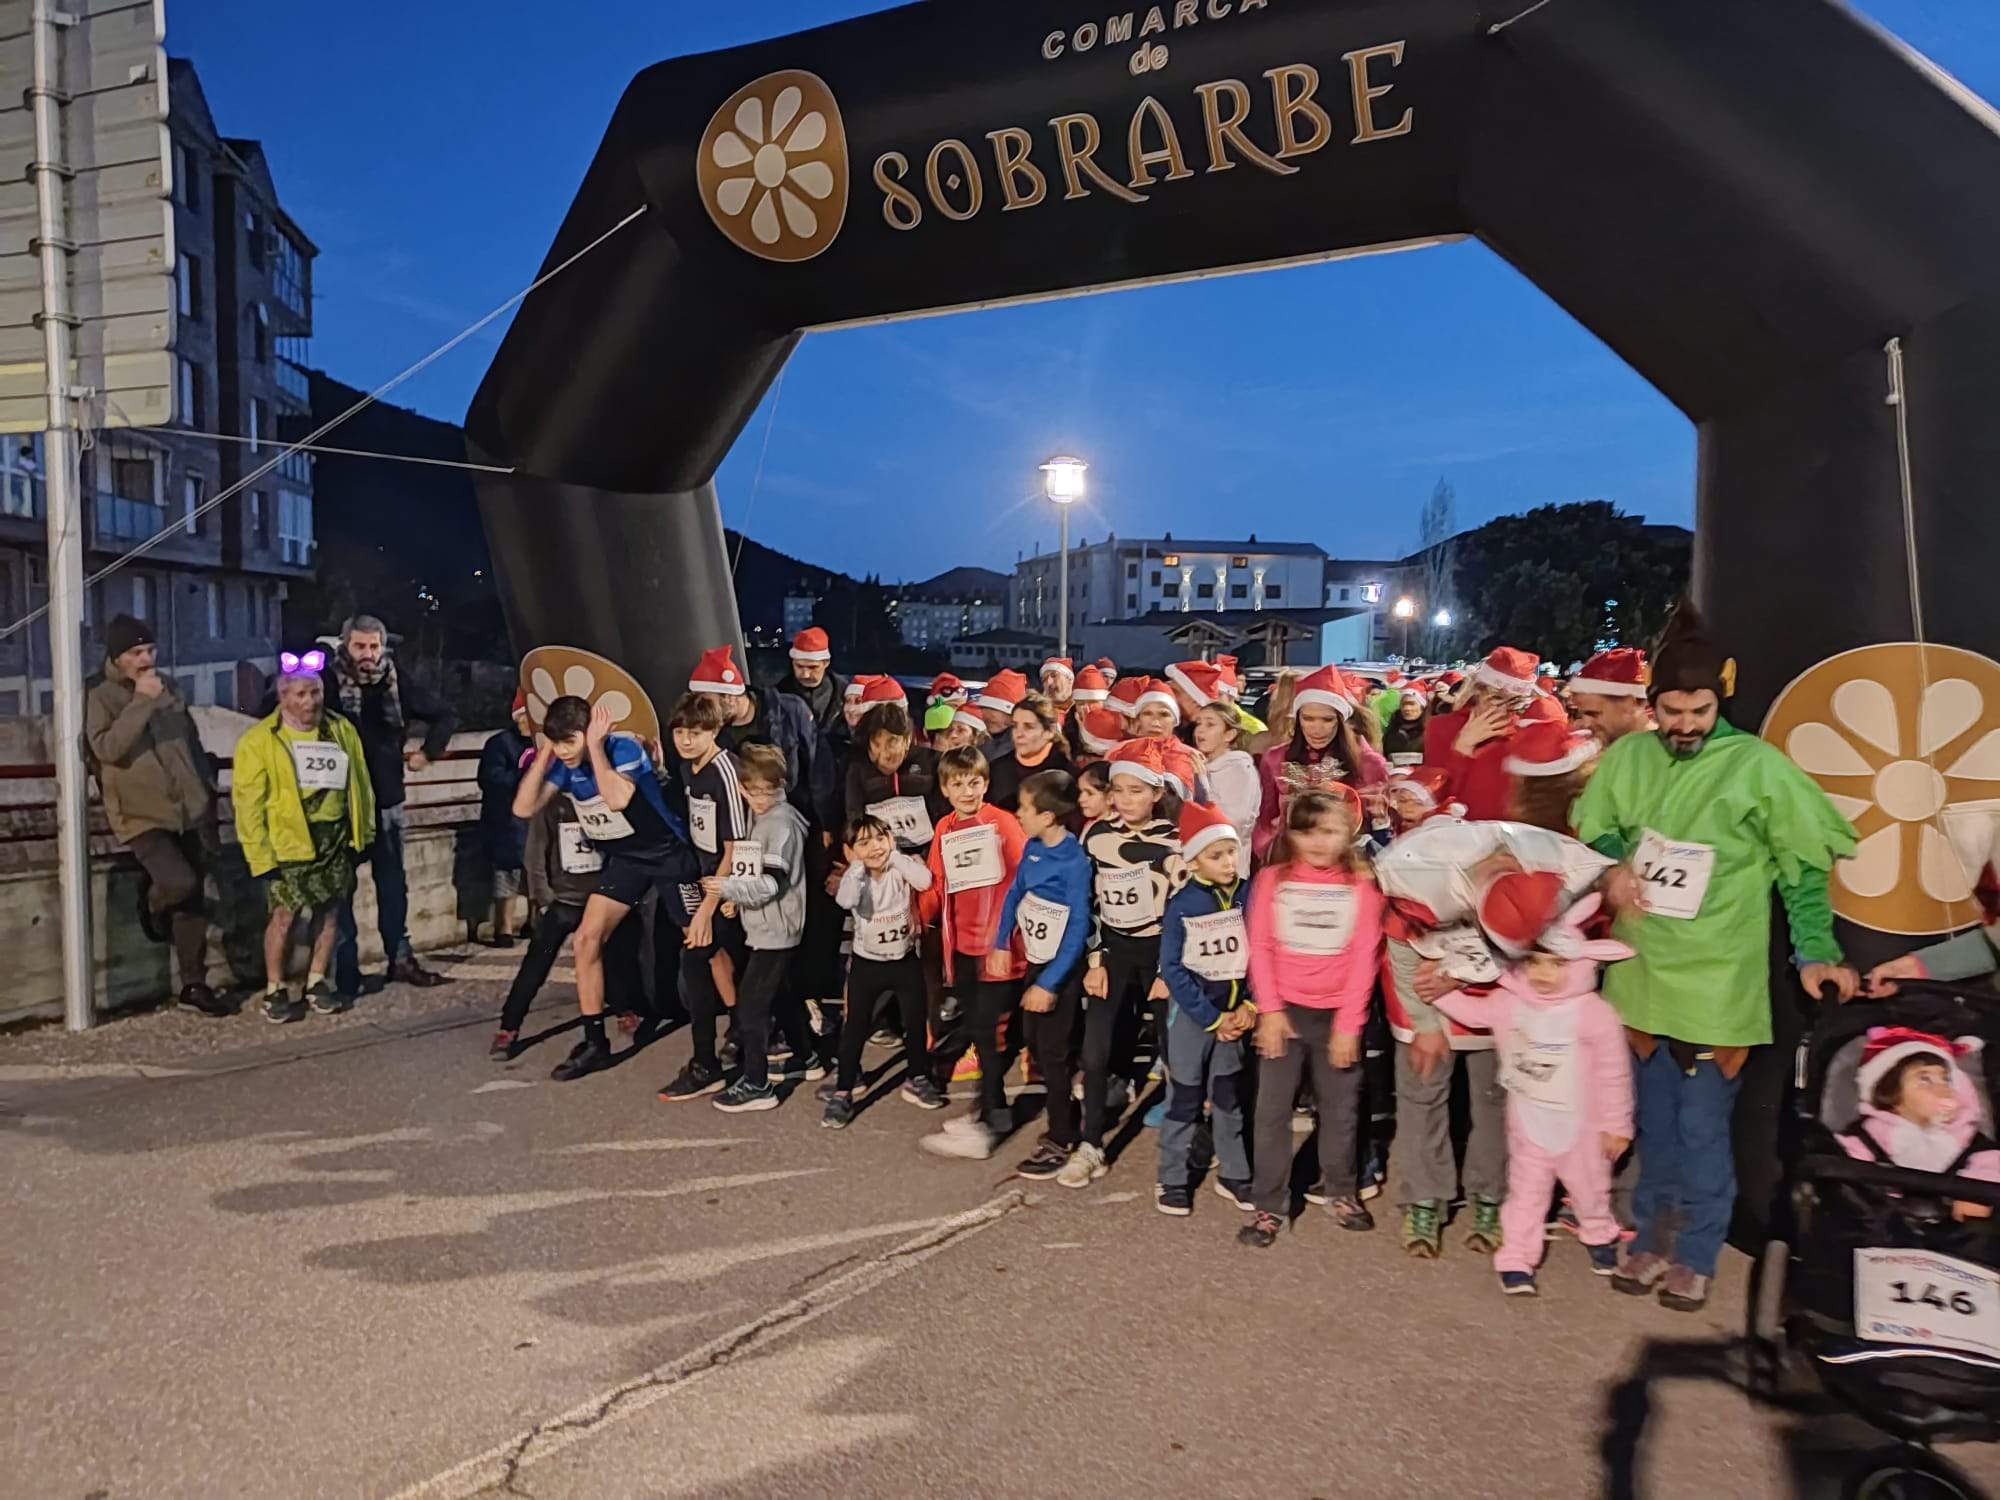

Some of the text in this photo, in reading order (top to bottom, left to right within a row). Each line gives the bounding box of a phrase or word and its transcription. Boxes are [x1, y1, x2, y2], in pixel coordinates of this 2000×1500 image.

[1129, 42, 1169, 76] de
[872, 40, 1414, 231] SOBRARBE
[306, 757, 336, 771] 230
[1640, 861, 1687, 888] 142
[1103, 887, 1139, 905] 126
[1199, 936, 1240, 956] 110
[1889, 1282, 1976, 1315] 146
